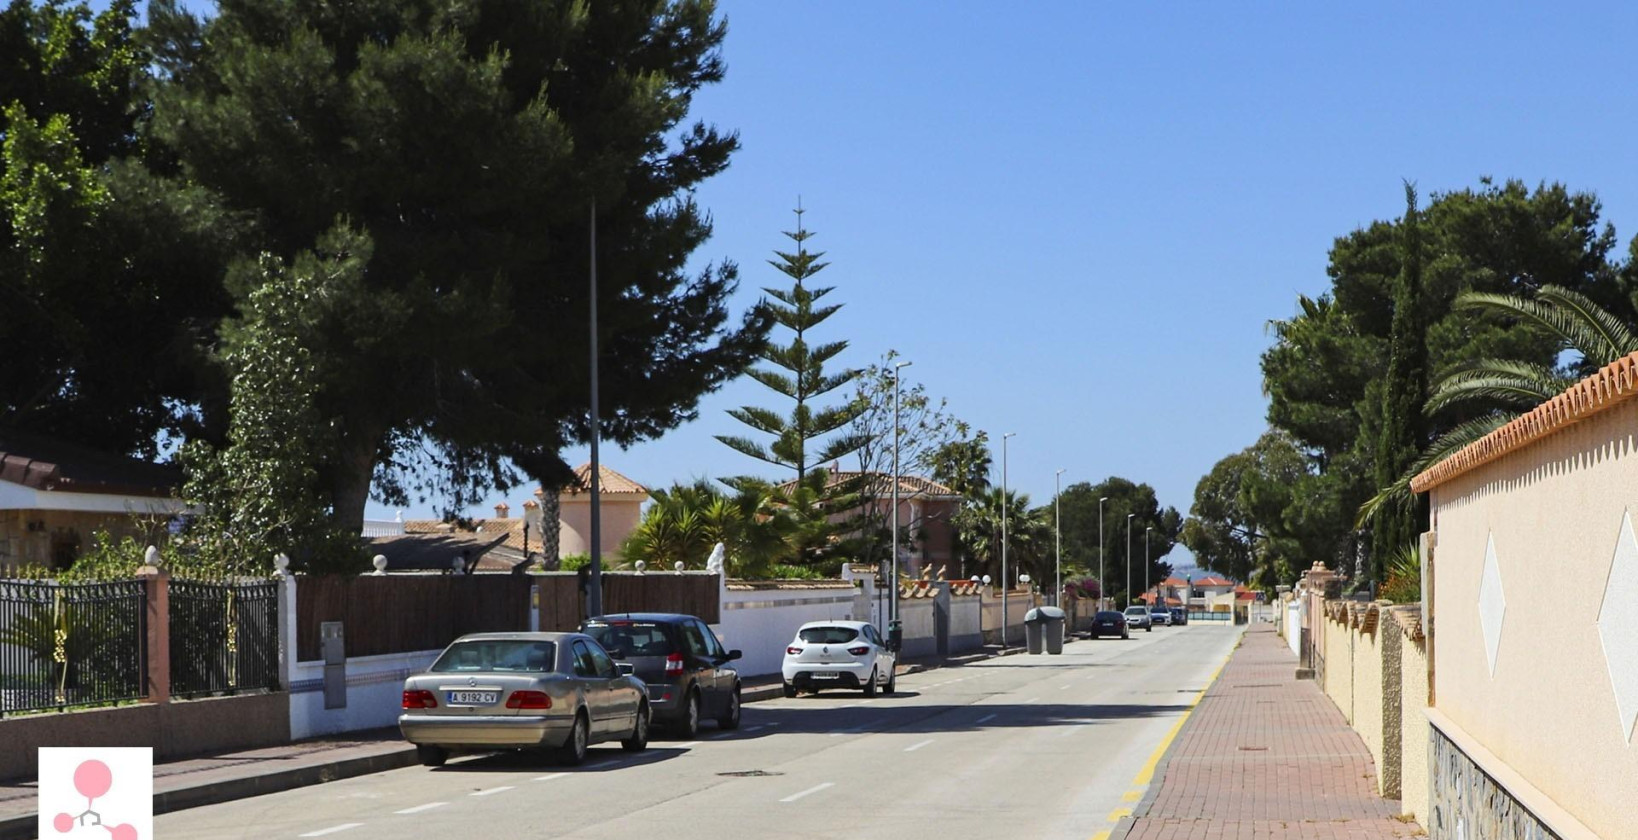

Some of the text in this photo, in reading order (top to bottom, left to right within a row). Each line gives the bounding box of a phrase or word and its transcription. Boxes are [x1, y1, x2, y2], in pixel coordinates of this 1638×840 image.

[452, 693, 496, 702] A 9192 CV
